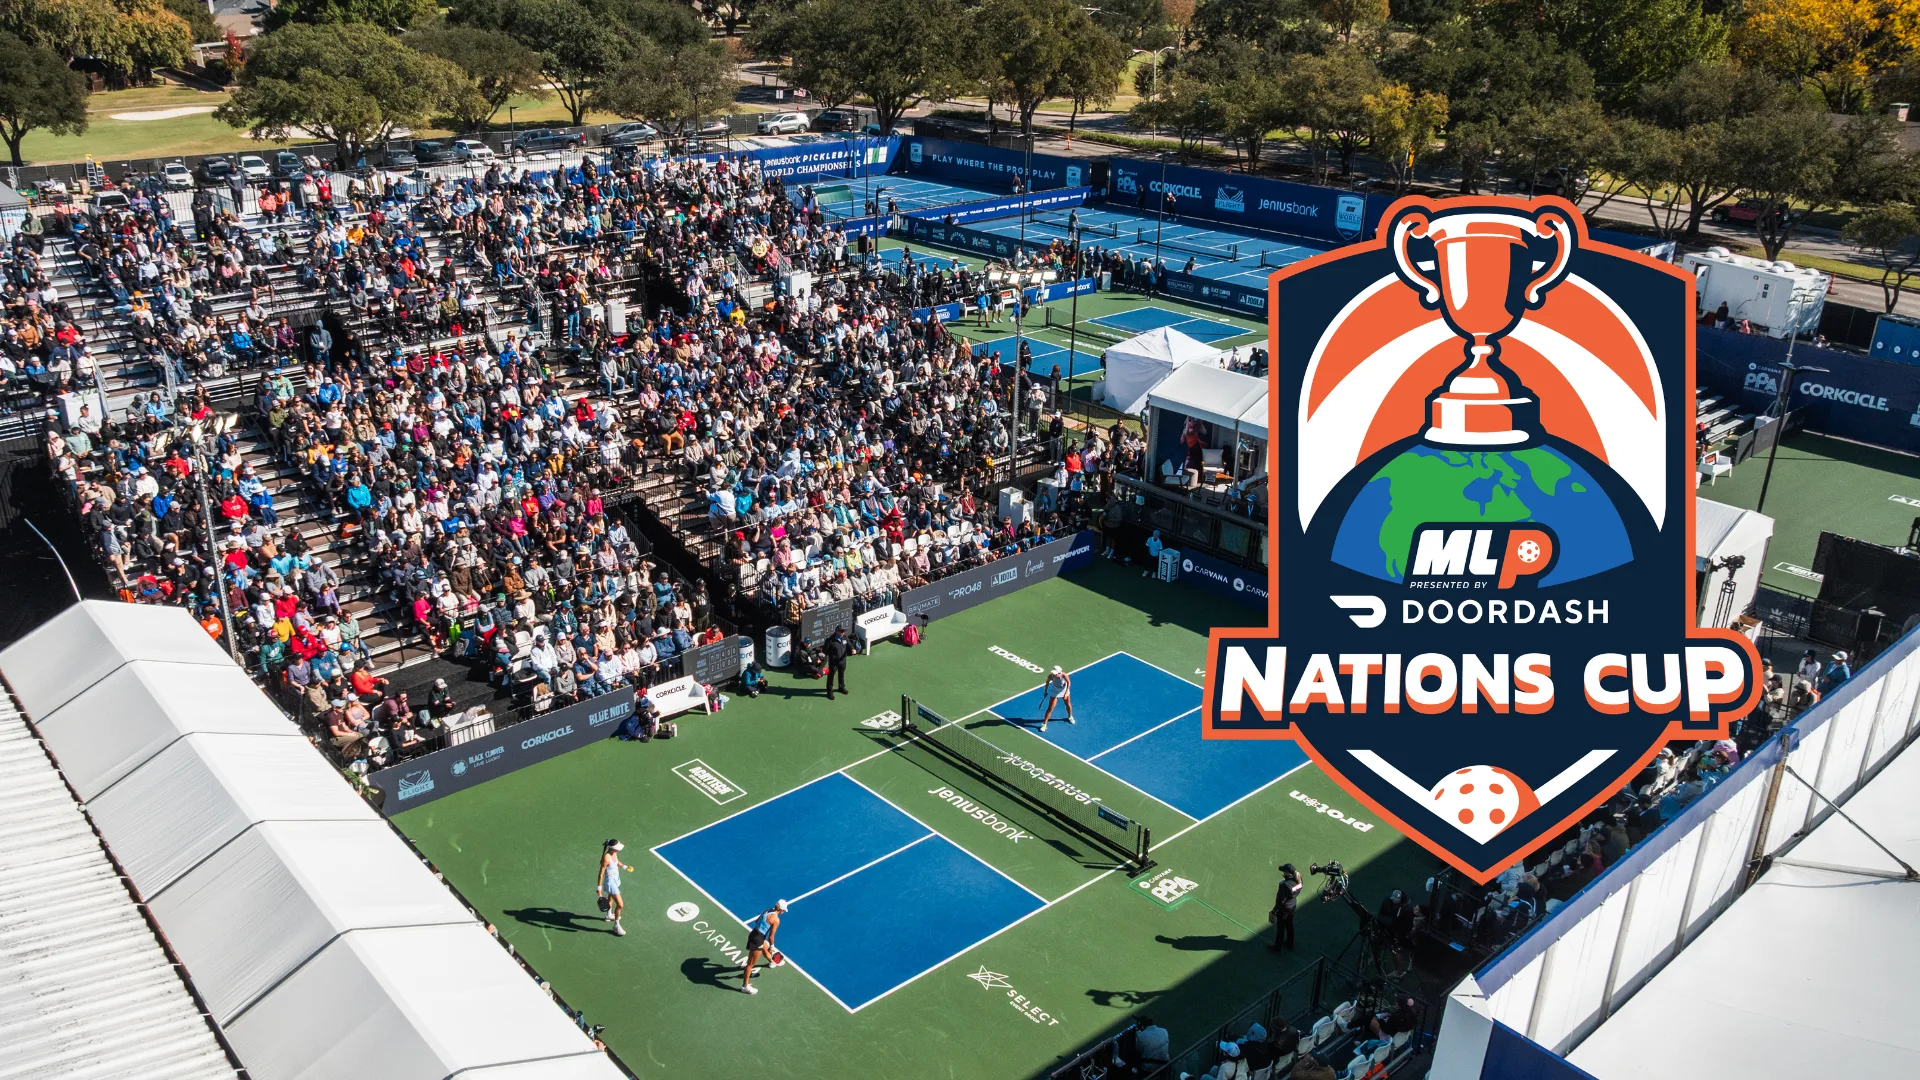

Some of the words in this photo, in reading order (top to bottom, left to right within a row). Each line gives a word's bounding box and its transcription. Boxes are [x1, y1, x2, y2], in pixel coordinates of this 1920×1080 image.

[763, 167, 795, 178] WORLD
[932, 154, 953, 164] PLAY
[956, 157, 985, 169] WHERE
[988, 162, 1003, 172] THE
[1006, 165, 1029, 176] PROS
[1032, 169, 1056, 179] PLAY
[1218, 201, 1241, 209] FLIGHT
[1744, 373, 1777, 392] PPA
[1194, 565, 1229, 584] CARVANA
[953, 581, 982, 599] PRO48
[588, 709, 609, 726] BLUE
[610, 701, 630, 718] NOTE
[468, 753, 484, 764] BLACK
[485, 746, 505, 758] CLOVER
[403, 784, 429, 796] FLIGHT
[1148, 868, 1173, 883] CARVANA
[1151, 876, 1199, 902] PPA
[1006, 989, 1059, 1027] SELECT
[1009, 1001, 1025, 1013] EVENT
[1023, 1011, 1041, 1024] GROUP
